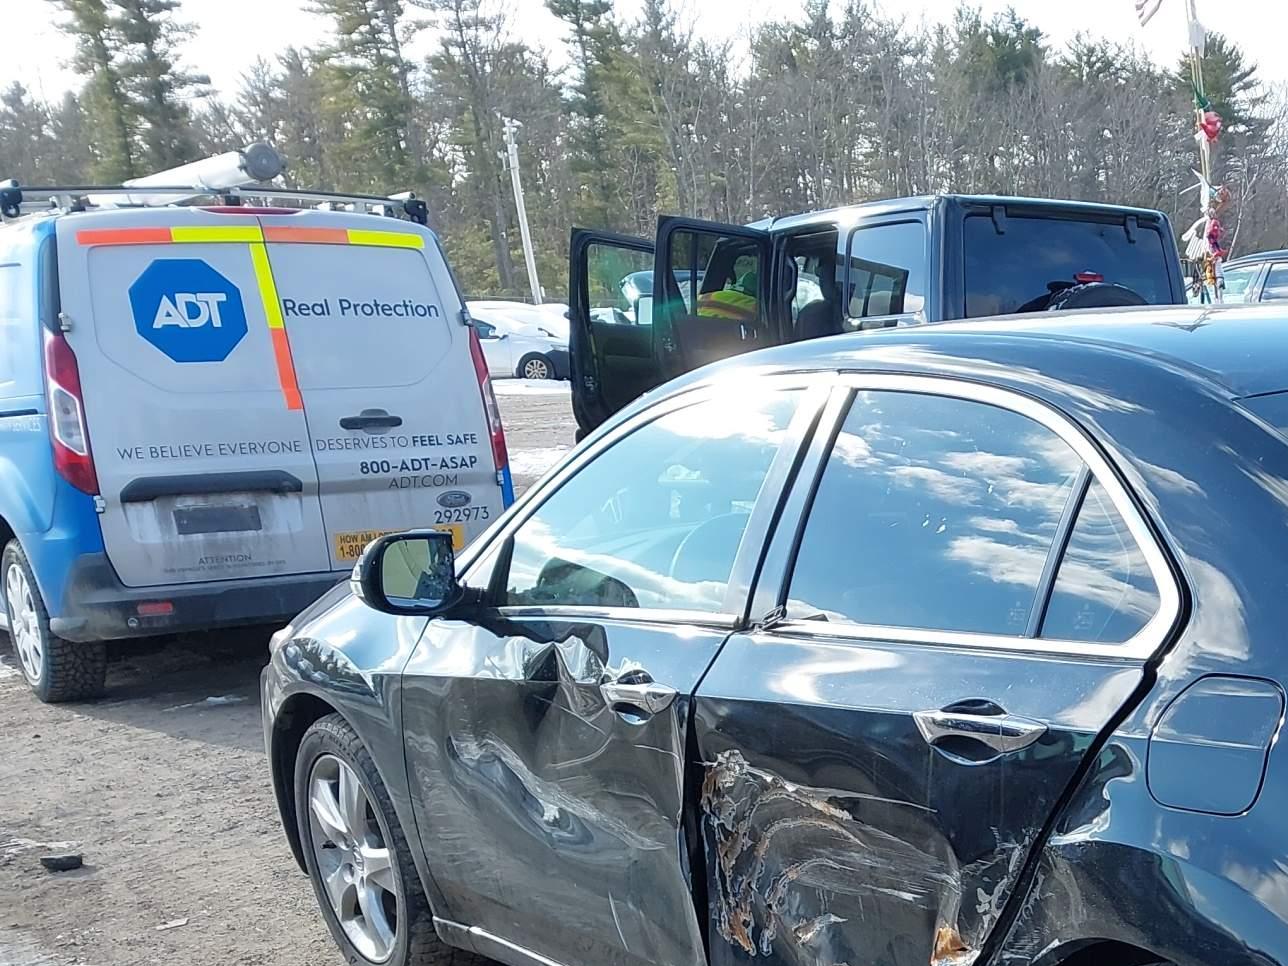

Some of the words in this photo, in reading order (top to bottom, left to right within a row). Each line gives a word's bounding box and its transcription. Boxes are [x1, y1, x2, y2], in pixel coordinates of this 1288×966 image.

[152, 292, 227, 328] ADT
[282, 299, 330, 317] Real
[338, 299, 439, 317] Protection
[117, 446, 145, 460] WE
[149, 444, 214, 459] BELIEVE
[218, 440, 303, 456] EVERYONE
[316, 436, 388, 451] DESERVES
[391, 436, 409, 448] TO
[412, 435, 443, 447] FEEL
[447, 433, 478, 446] SAFE
[360, 455, 478, 475] 800-ADT-ASAP
[388, 473, 458, 489] ADT.COM
[434, 506, 490, 524] 292973
[339, 534, 358, 545] HOW
[198, 553, 252, 565] ATTENTION
